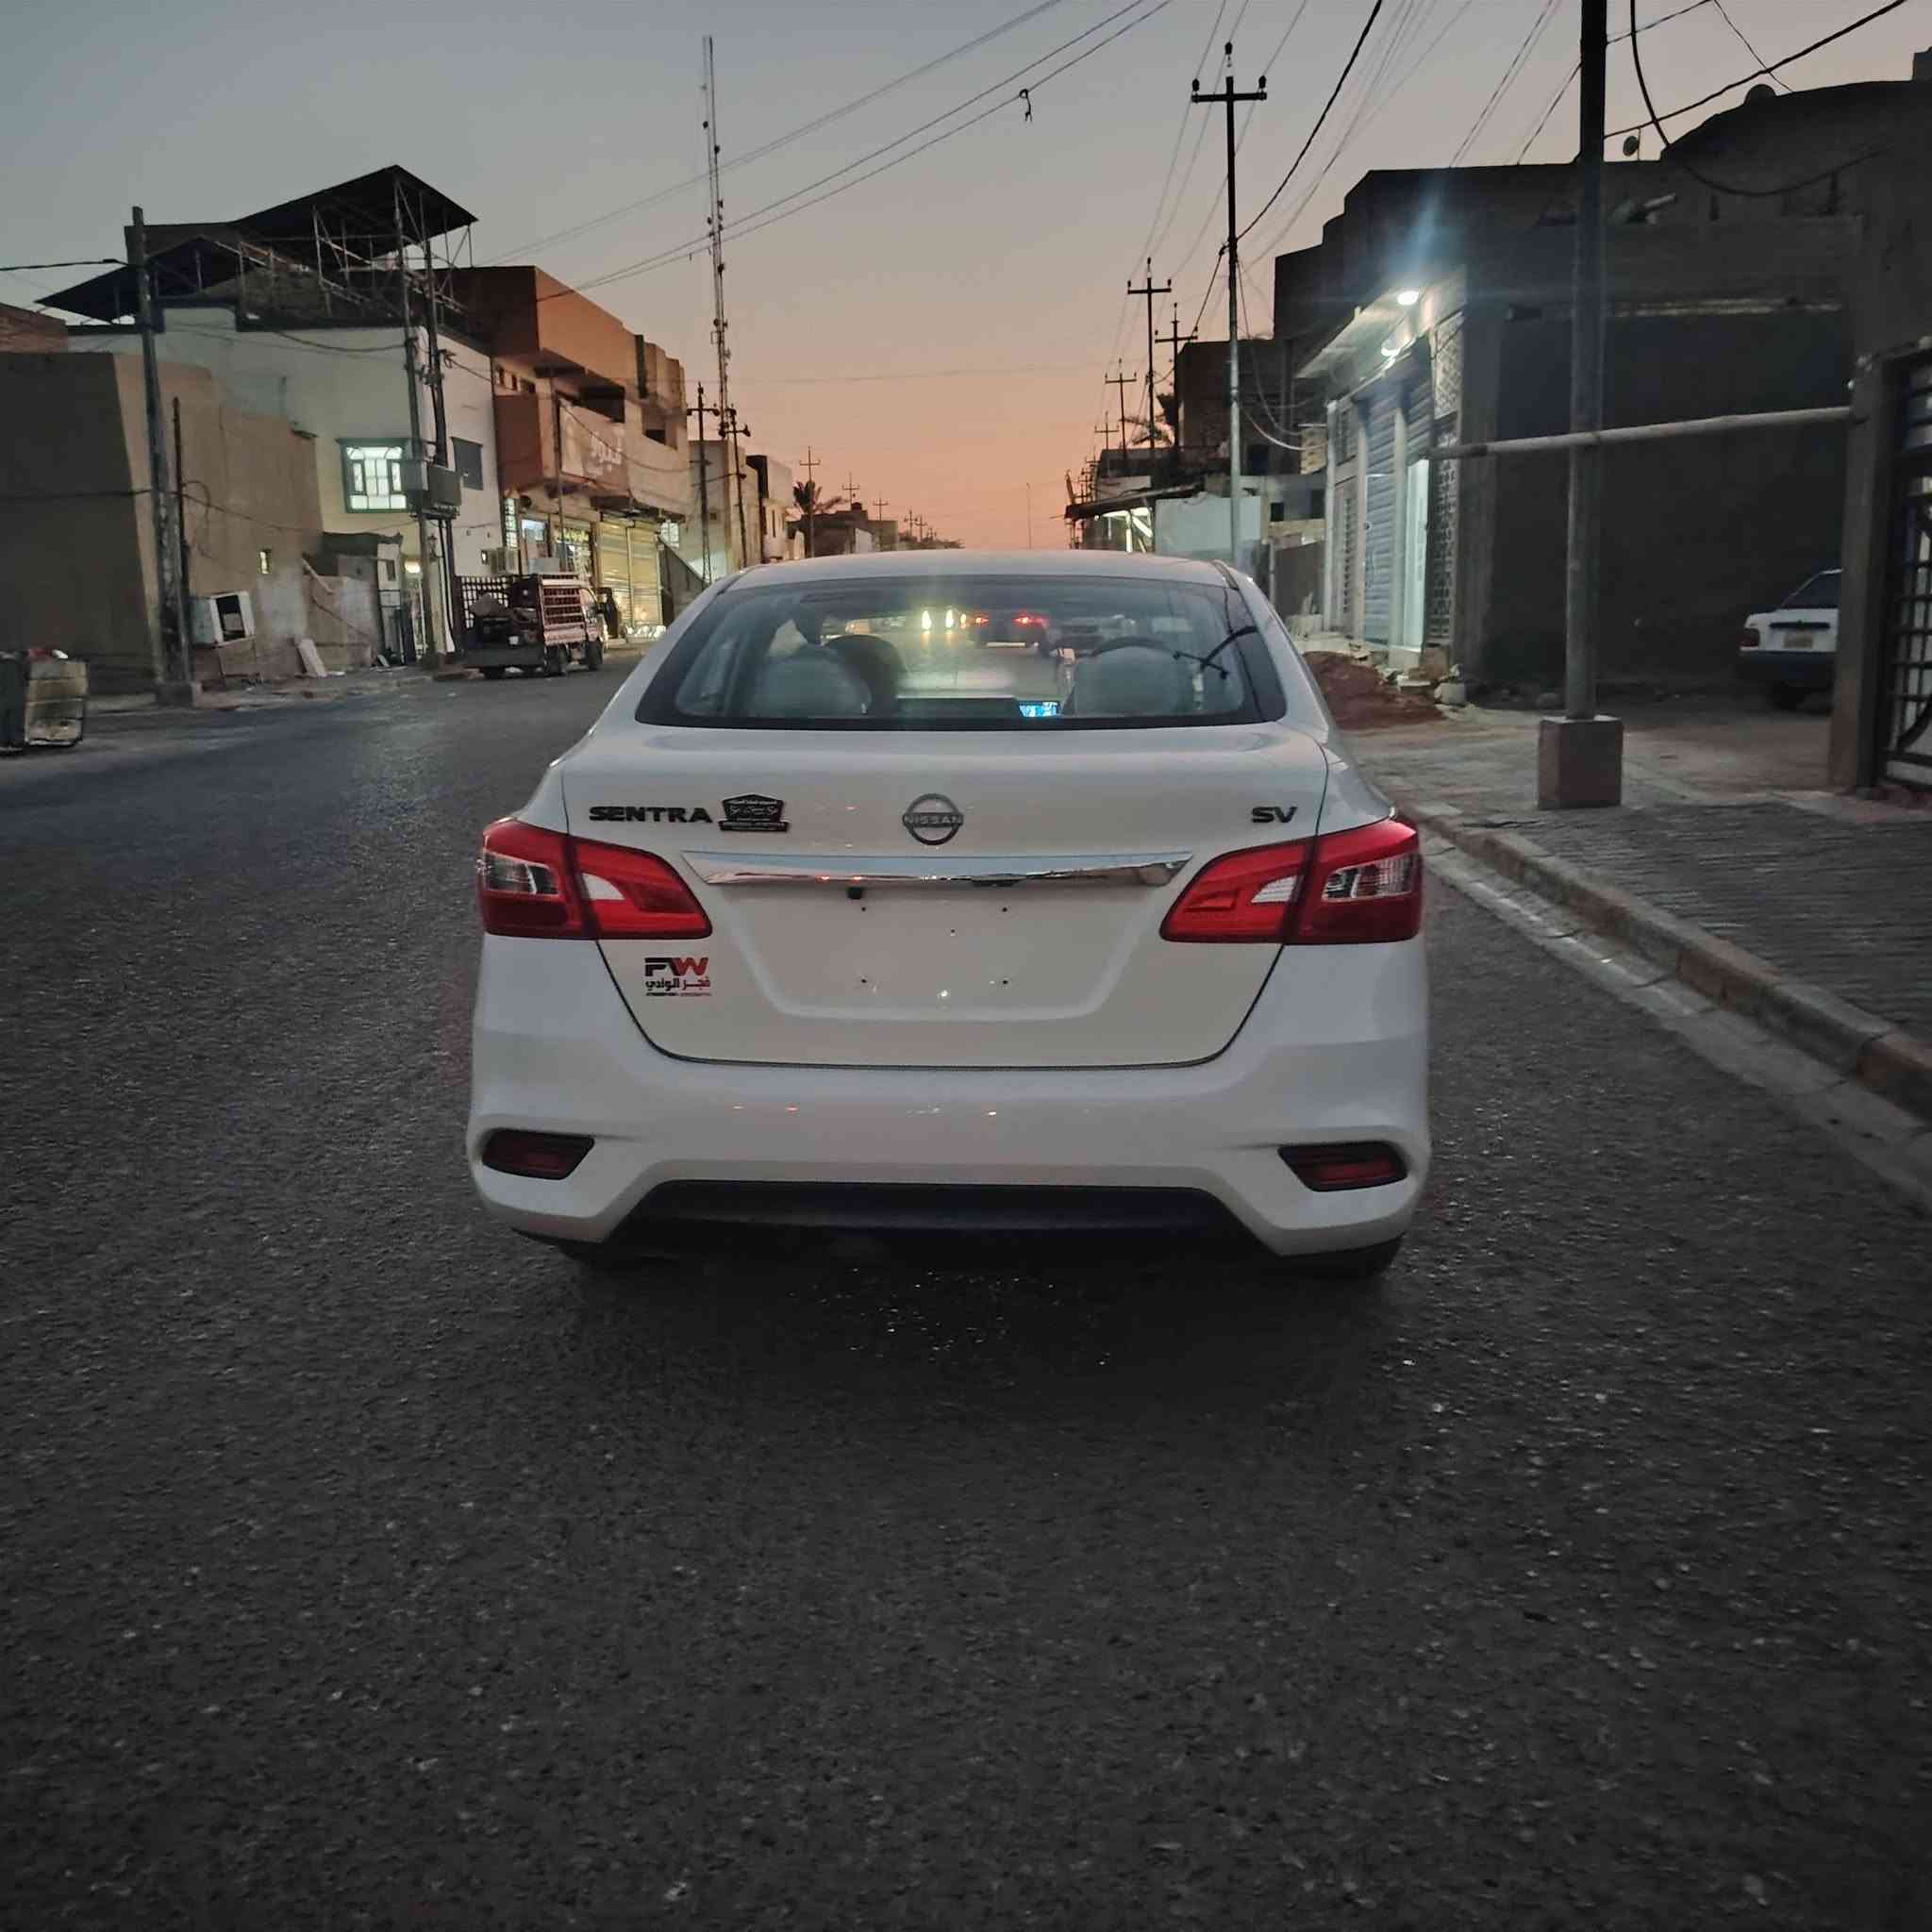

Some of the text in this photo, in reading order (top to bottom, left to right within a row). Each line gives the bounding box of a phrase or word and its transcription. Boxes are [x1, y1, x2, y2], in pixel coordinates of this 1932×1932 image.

[589, 806, 713, 823] SENTRA
[1252, 806, 1297, 823] SV
[645, 977, 680, 991] الوادي
